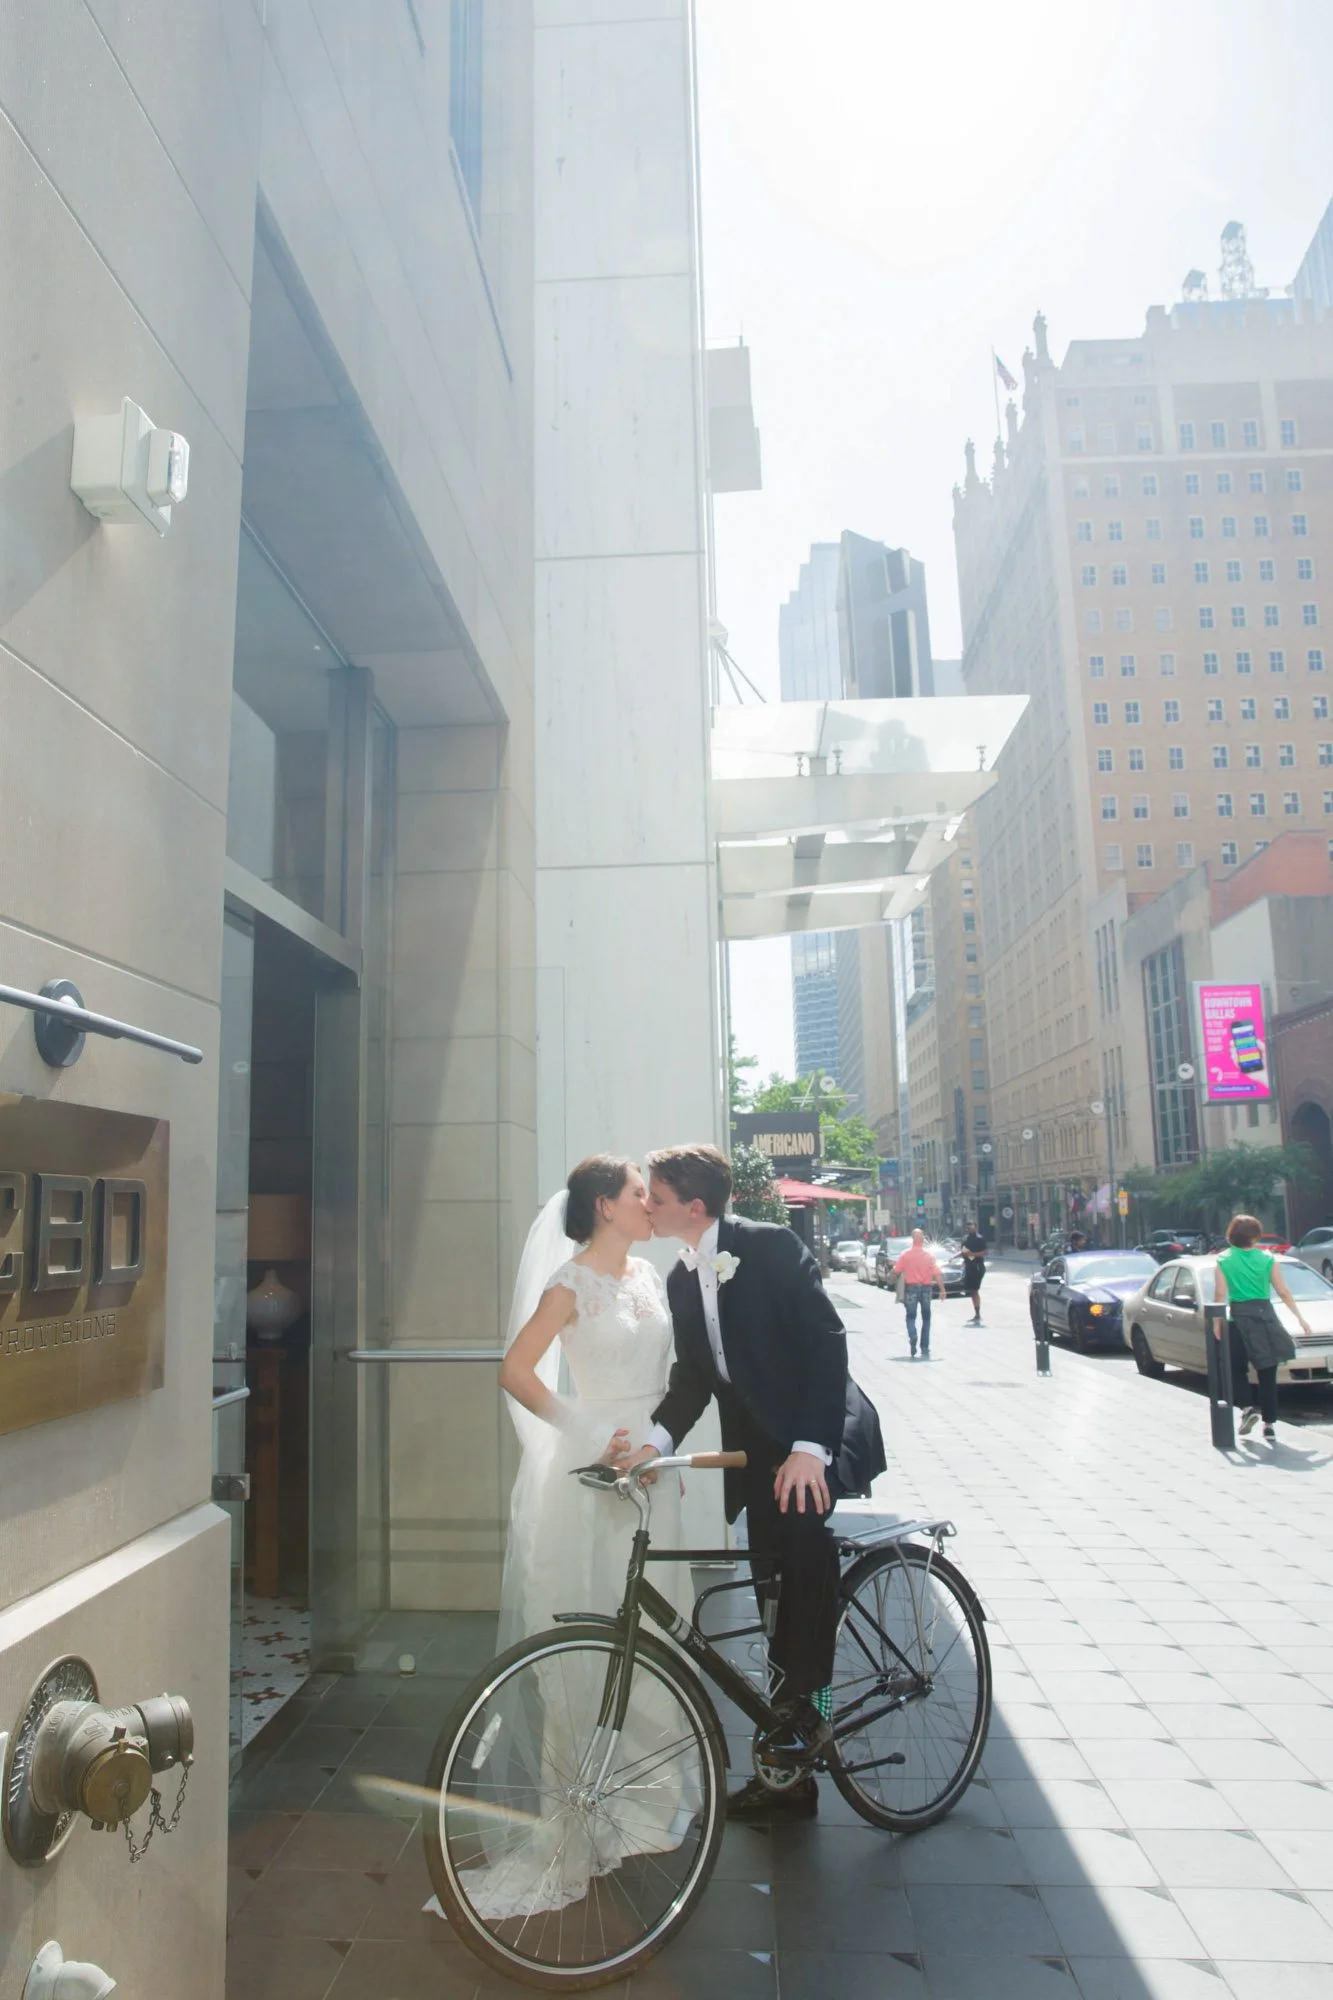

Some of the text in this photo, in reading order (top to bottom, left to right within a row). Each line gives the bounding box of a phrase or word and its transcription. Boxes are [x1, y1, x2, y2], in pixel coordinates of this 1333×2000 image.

[1204, 997, 1252, 1008] DOWNTOWN
[1205, 1008, 1235, 1019] DALLAS
[752, 1132, 815, 1156] AMERICANO
[0, 1314, 116, 1355] ROVISIONS
